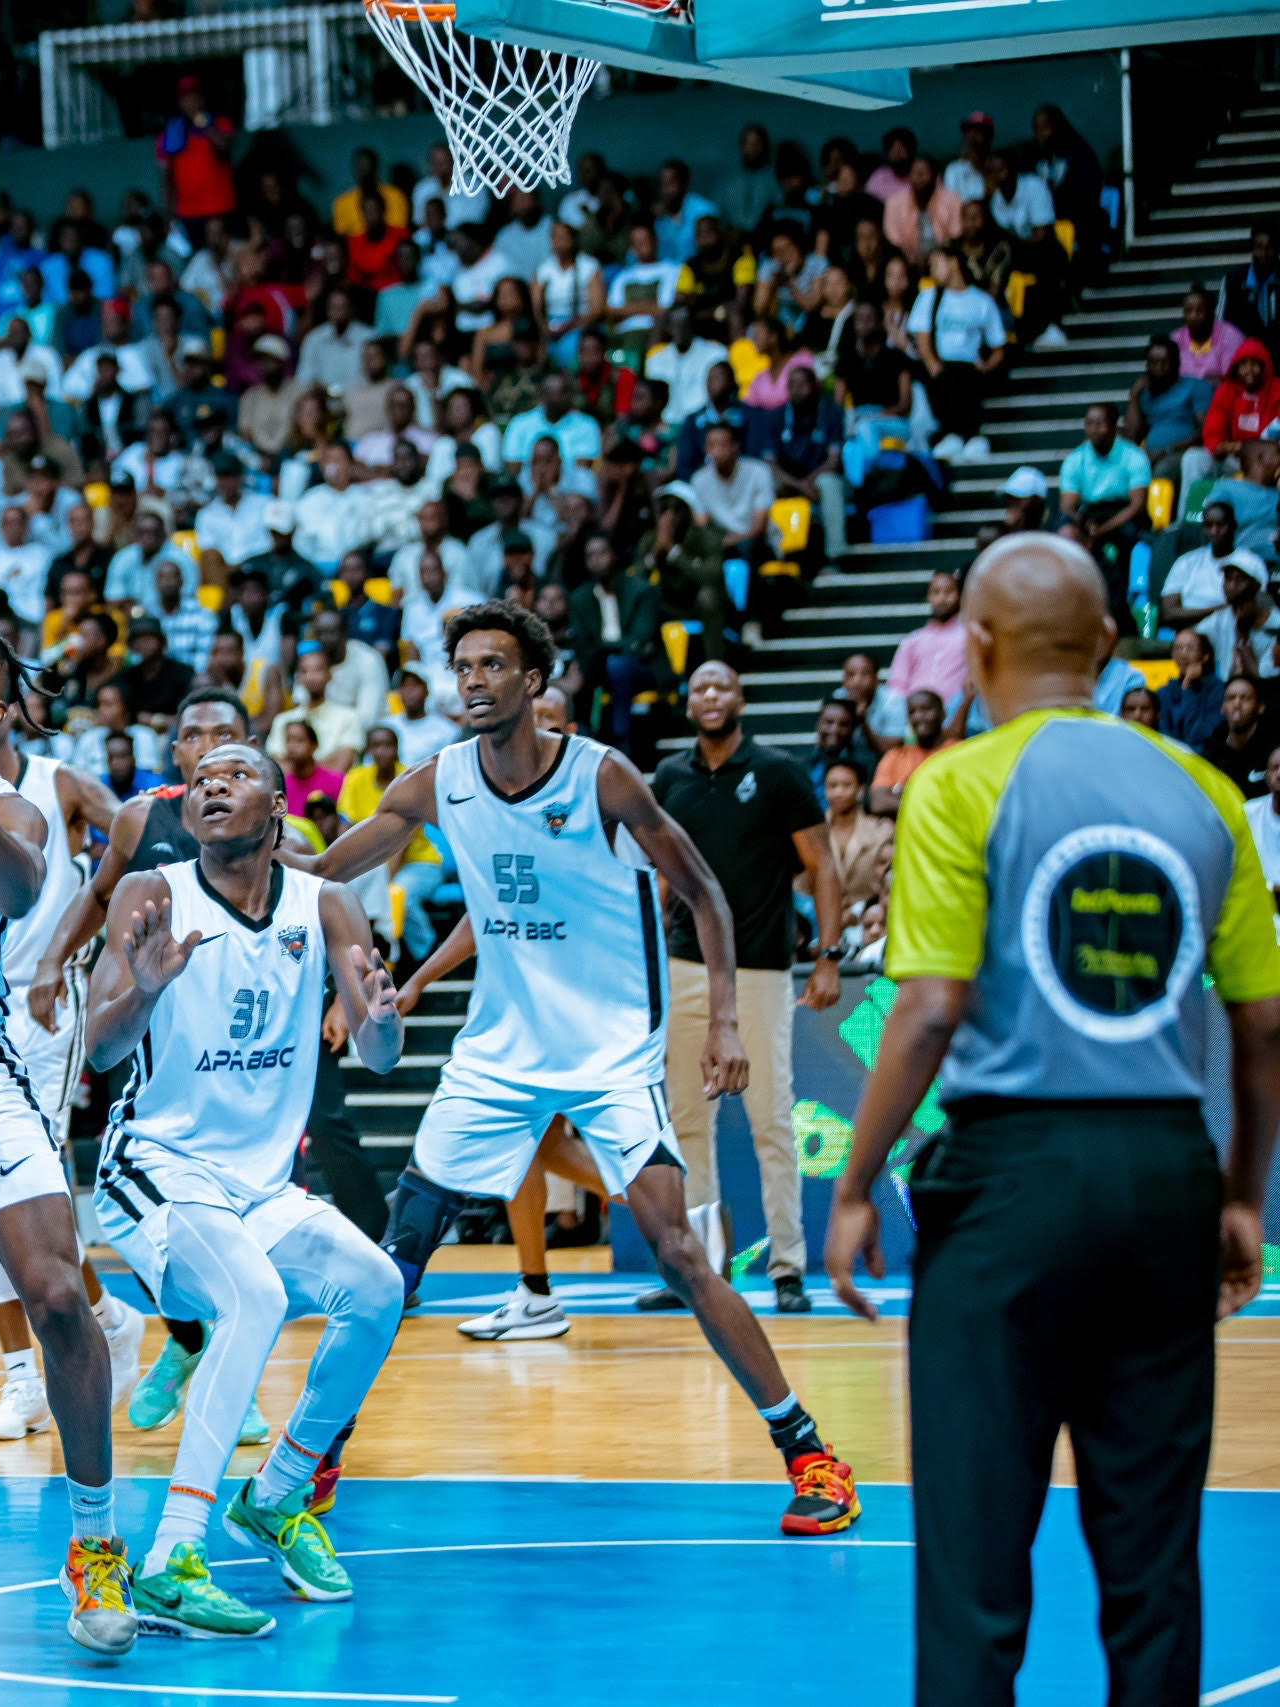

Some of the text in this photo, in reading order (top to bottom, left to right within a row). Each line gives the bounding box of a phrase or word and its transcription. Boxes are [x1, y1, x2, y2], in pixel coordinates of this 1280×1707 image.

[493, 853, 540, 904] 55
[482, 917, 568, 941] APR BBC
[229, 988, 269, 1039] 31
[246, 1046, 296, 1070] BBC
